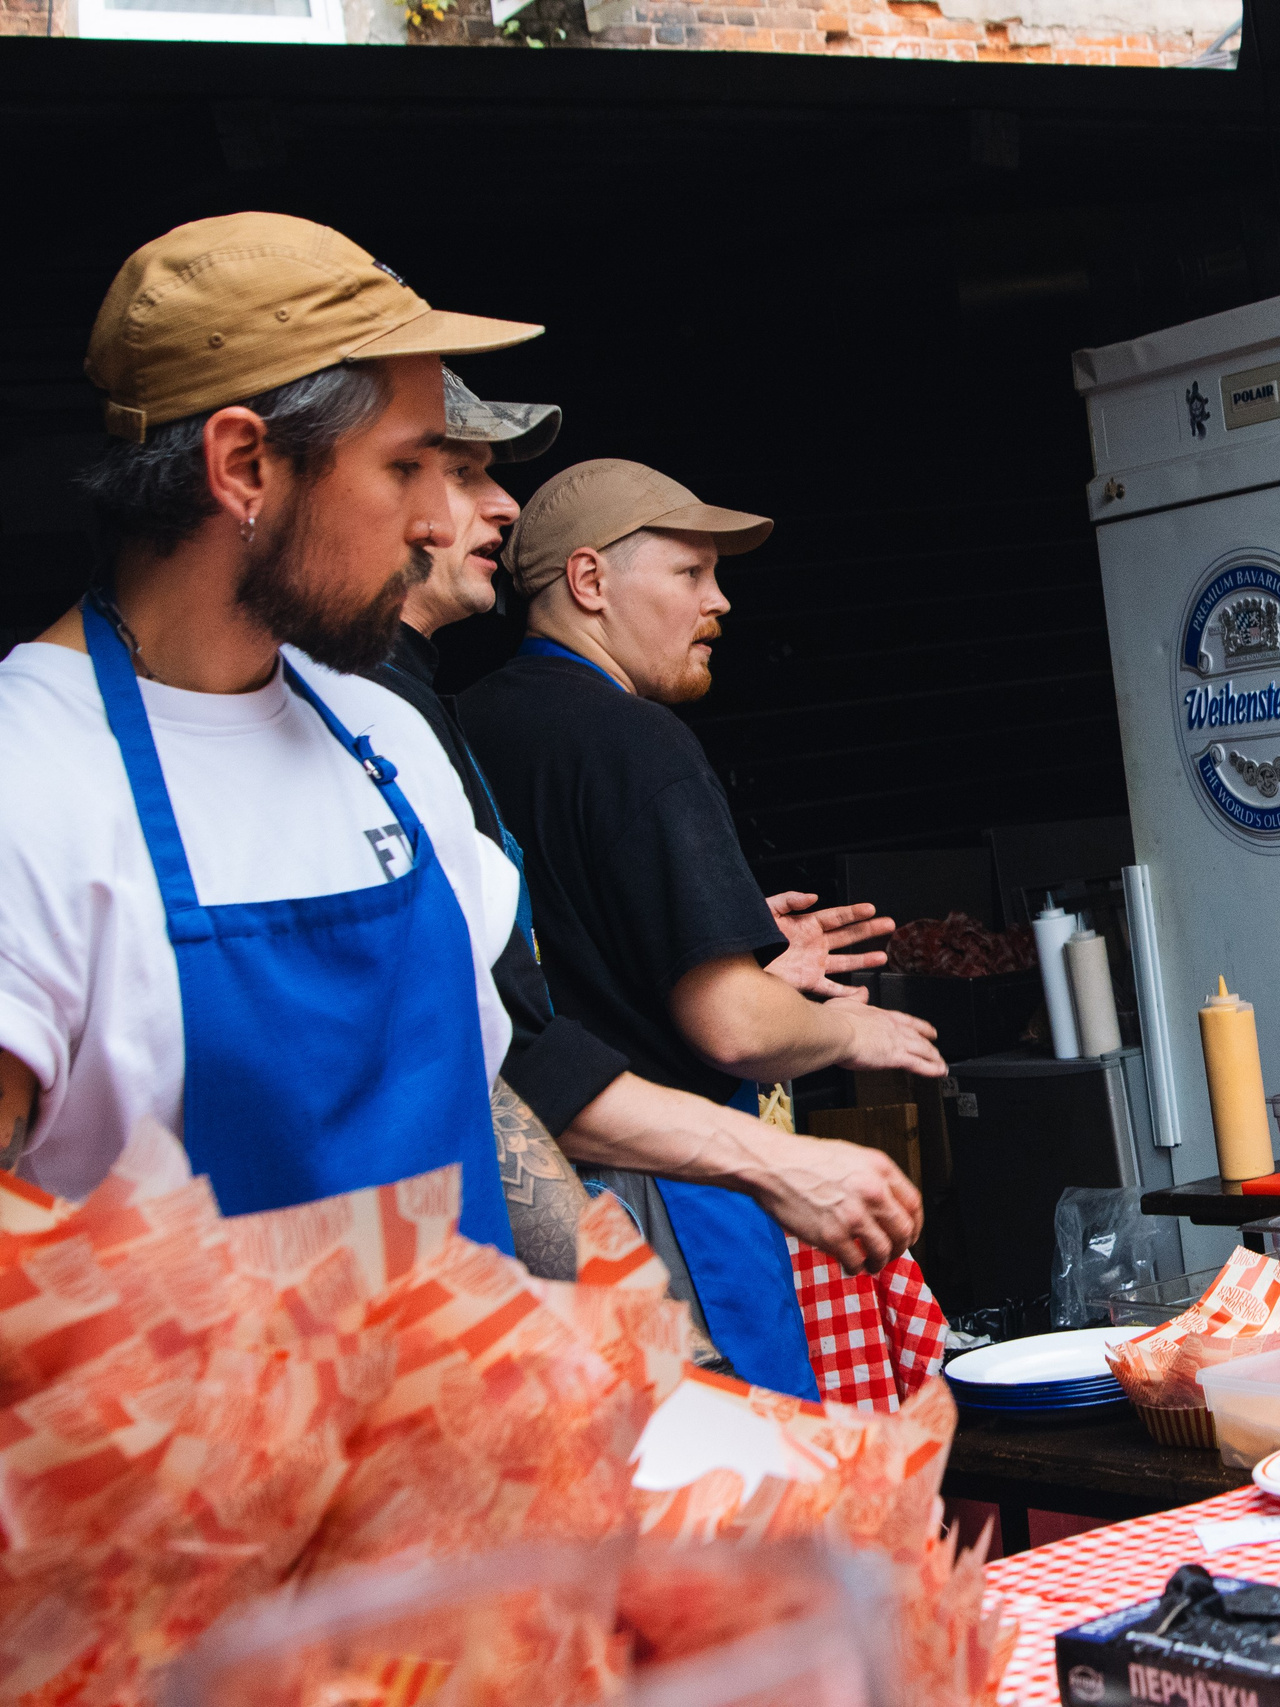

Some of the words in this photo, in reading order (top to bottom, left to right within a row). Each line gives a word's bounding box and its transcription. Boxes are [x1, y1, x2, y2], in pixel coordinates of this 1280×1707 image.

[1233, 385, 1274, 404] POLAIR
[1193, 575, 1235, 631] PREMIUM
[1203, 760, 1217, 791] THE
[1218, 788, 1262, 828] WORLD'S
[1220, 1286, 1268, 1318] UNDERDOG
[1241, 1308, 1264, 1323] DOGS
[1128, 1662, 1259, 1707] ПЕРЧАТКИ
